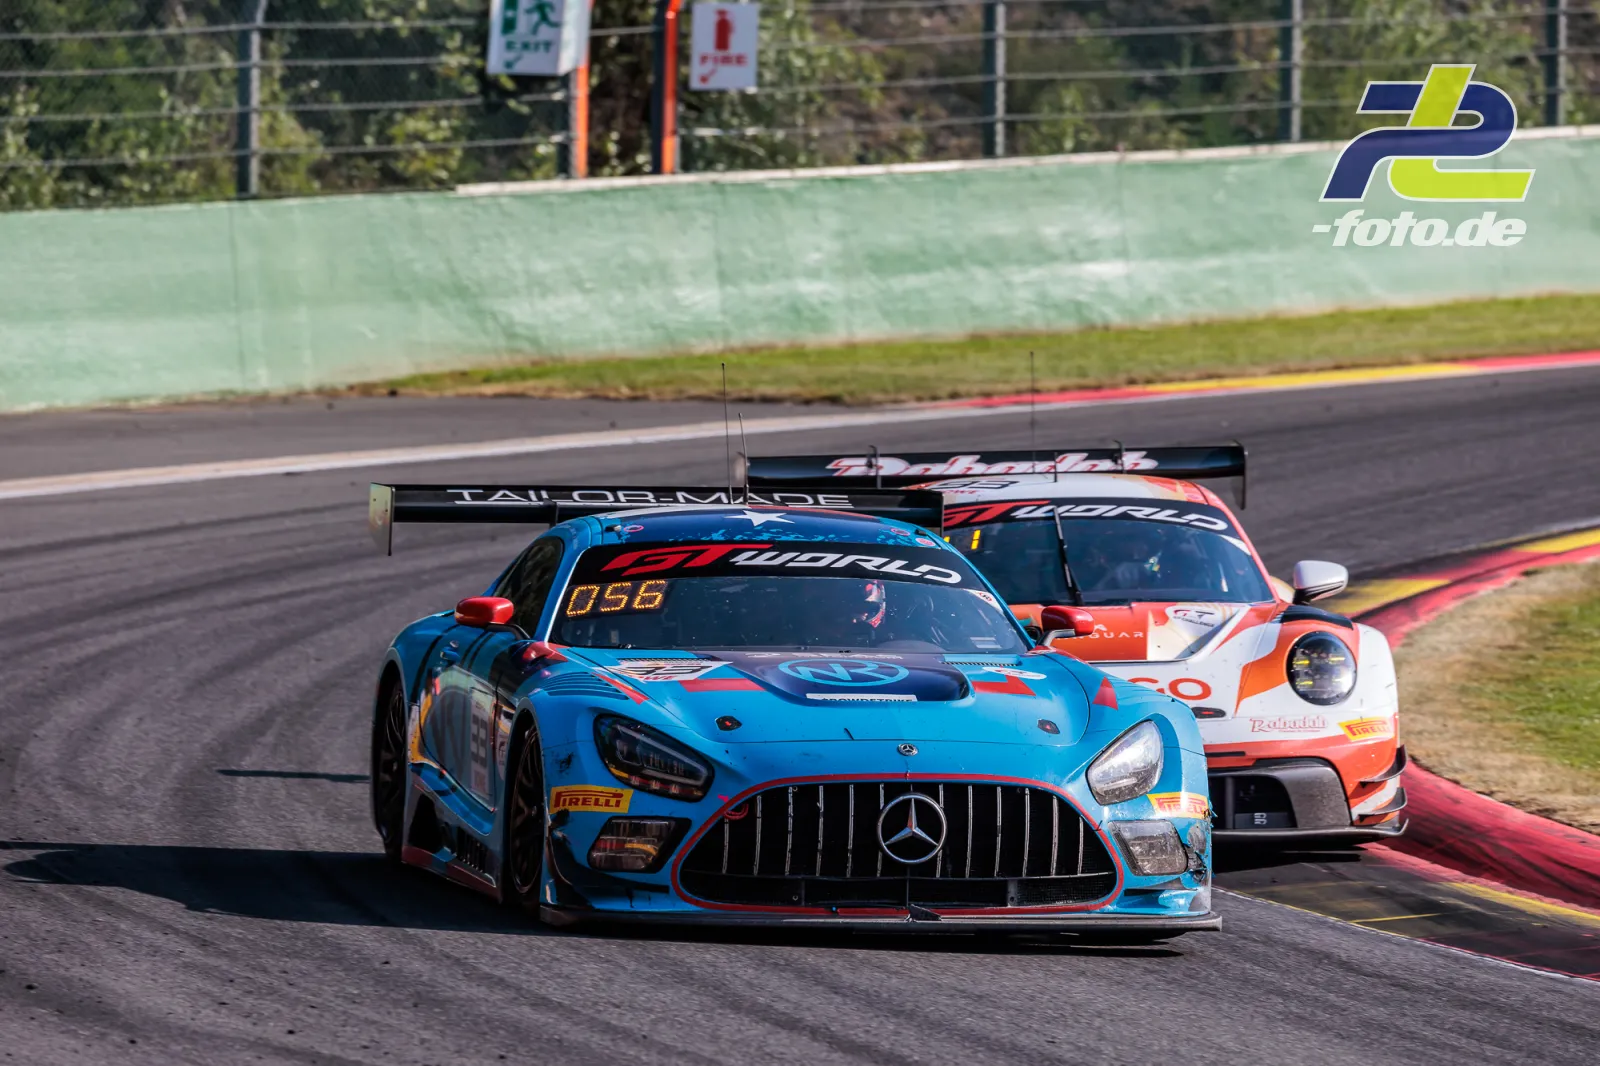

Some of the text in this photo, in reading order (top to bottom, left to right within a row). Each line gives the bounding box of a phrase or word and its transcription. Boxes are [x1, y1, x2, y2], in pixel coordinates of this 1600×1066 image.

[505, 39, 554, 53] EXIT
[699, 53, 748, 66] FIRE
[566, 580, 667, 617] 056
[1345, 720, 1391, 737] PIRELLI
[553, 789, 624, 808] PIRELLI
